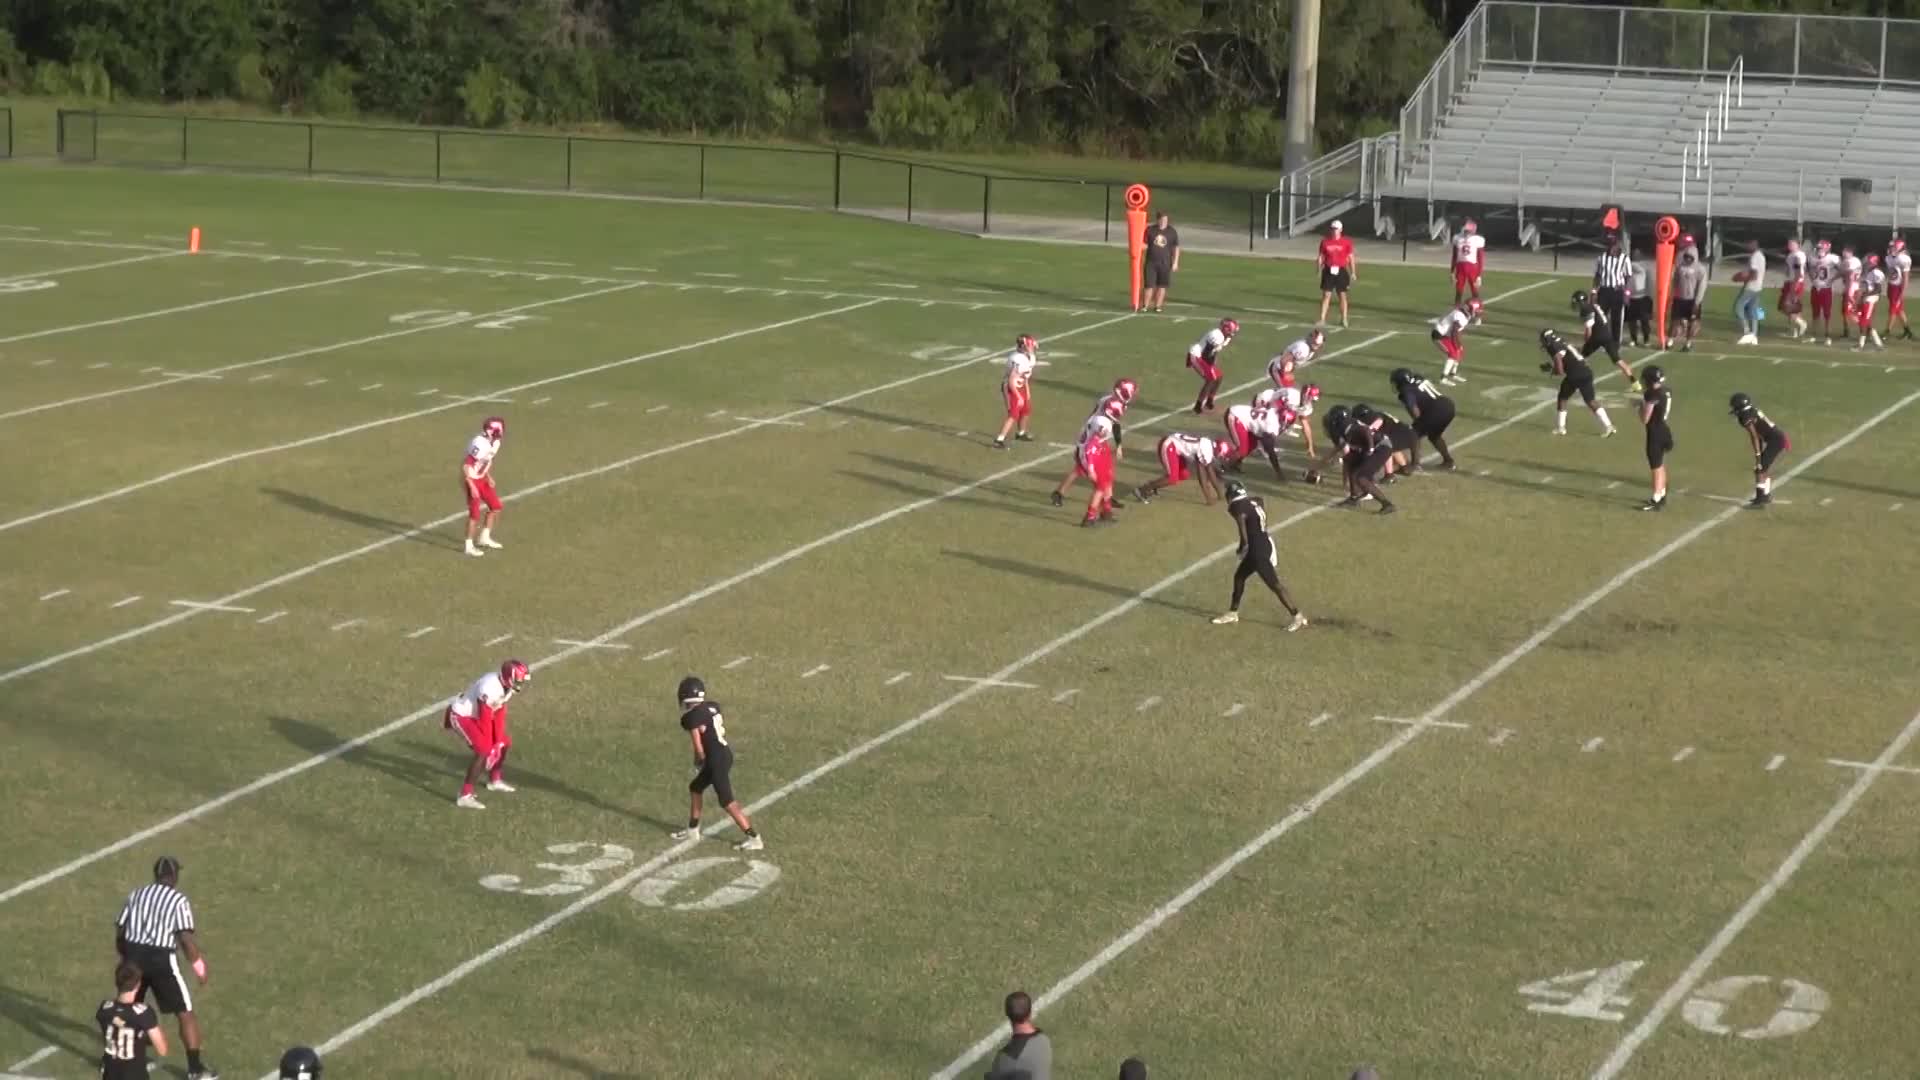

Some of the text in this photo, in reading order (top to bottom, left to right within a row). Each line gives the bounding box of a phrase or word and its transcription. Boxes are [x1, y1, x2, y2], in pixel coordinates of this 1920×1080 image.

[1603, 208, 1619, 229] 4
[477, 841, 781, 911] 30
[1517, 959, 1833, 1040] 40
